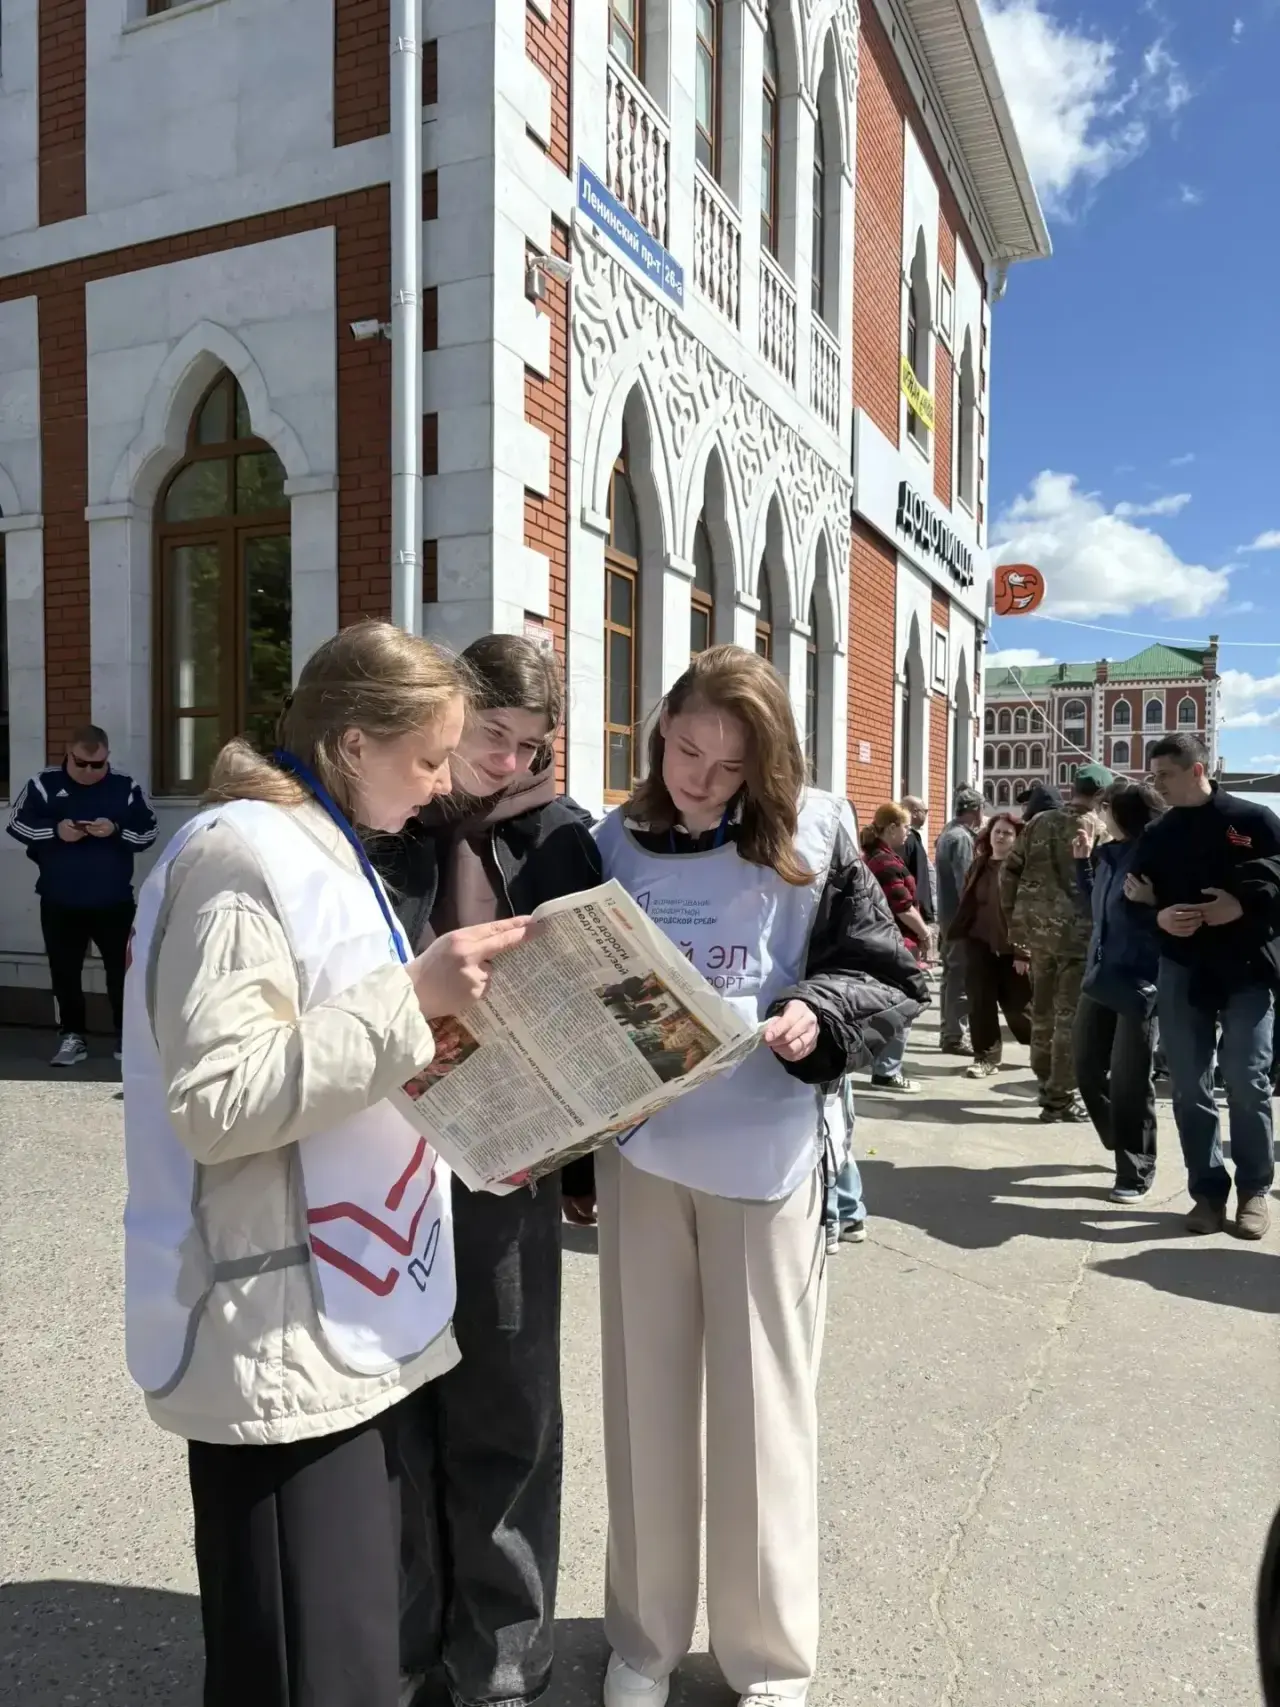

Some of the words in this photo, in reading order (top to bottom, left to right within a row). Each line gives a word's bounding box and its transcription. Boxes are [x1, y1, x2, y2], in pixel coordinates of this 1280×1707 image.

[581, 178, 639, 253] Ленинский
[641, 244, 661, 274] пр-т
[573, 907, 599, 937] ведут
[601, 945, 629, 975] музей
[584, 904, 600, 924] Все
[597, 925, 630, 960] дороги
[706, 945, 747, 970] ЭЛ
